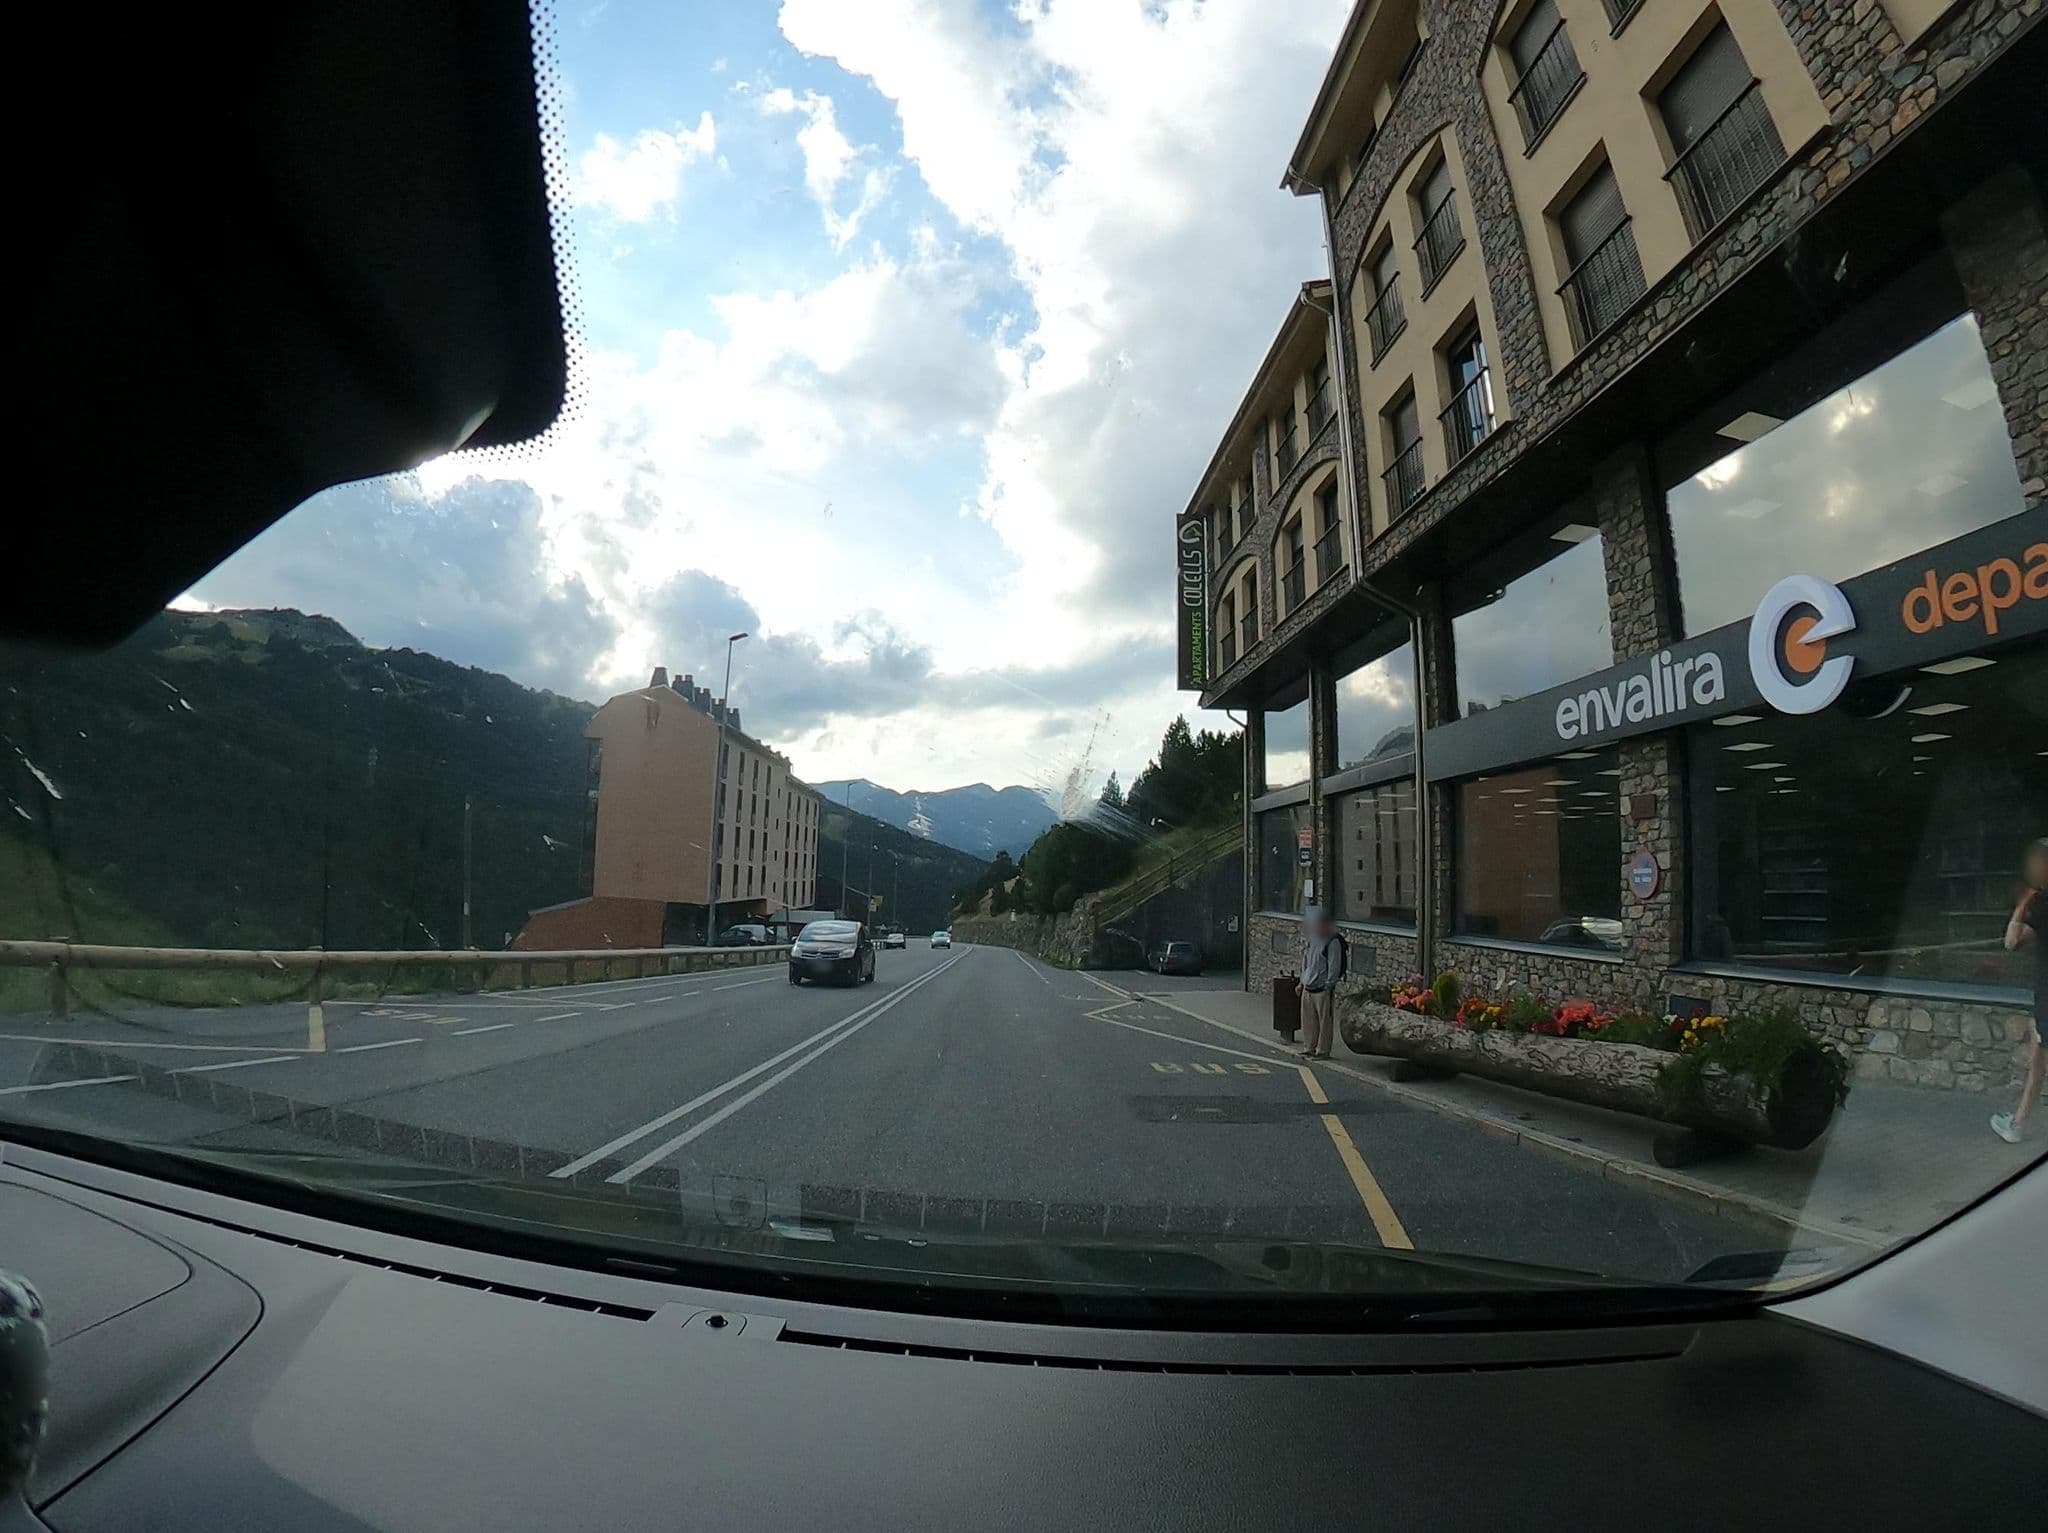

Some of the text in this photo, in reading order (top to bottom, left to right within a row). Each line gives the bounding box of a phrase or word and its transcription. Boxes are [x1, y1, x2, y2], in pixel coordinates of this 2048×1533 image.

[1183, 550, 1202, 684] APARTAMENTS COLELLS
[1556, 650, 1725, 740] envalira
[1903, 543, 2048, 634] depa
[1150, 1062, 1271, 1075] BUS
